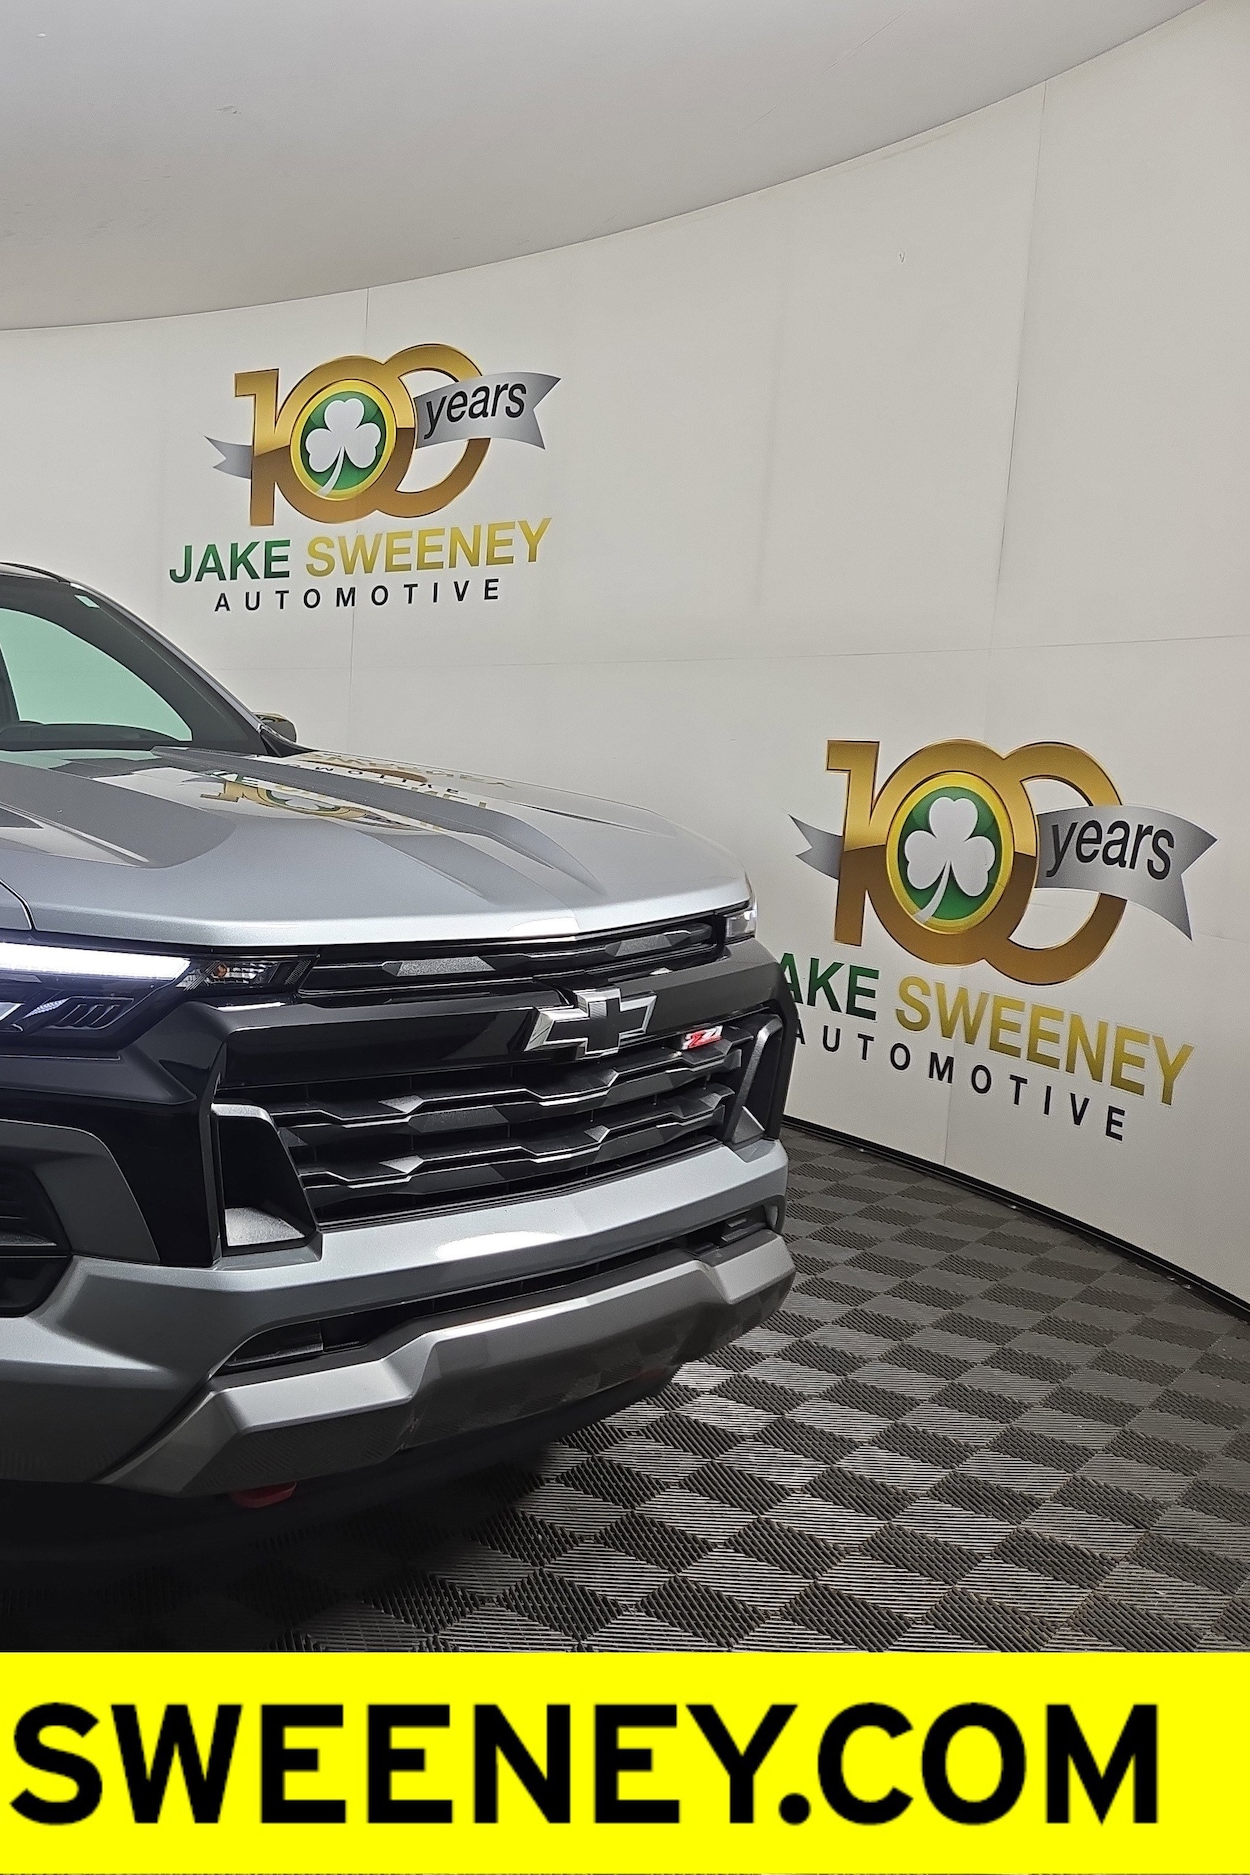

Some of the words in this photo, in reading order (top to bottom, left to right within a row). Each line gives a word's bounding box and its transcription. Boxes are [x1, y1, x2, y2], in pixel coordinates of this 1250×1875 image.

[423, 382, 527, 439] years
[169, 539, 291, 584] JAKE
[306, 517, 552, 578] SWEENEY
[214, 578, 500, 612] AUTOMOTIVE
[1046, 820, 1175, 880] years
[681, 1025, 724, 1050] Z71
[779, 952, 880, 1020] AKE
[895, 975, 1194, 1106] SWEENEY
